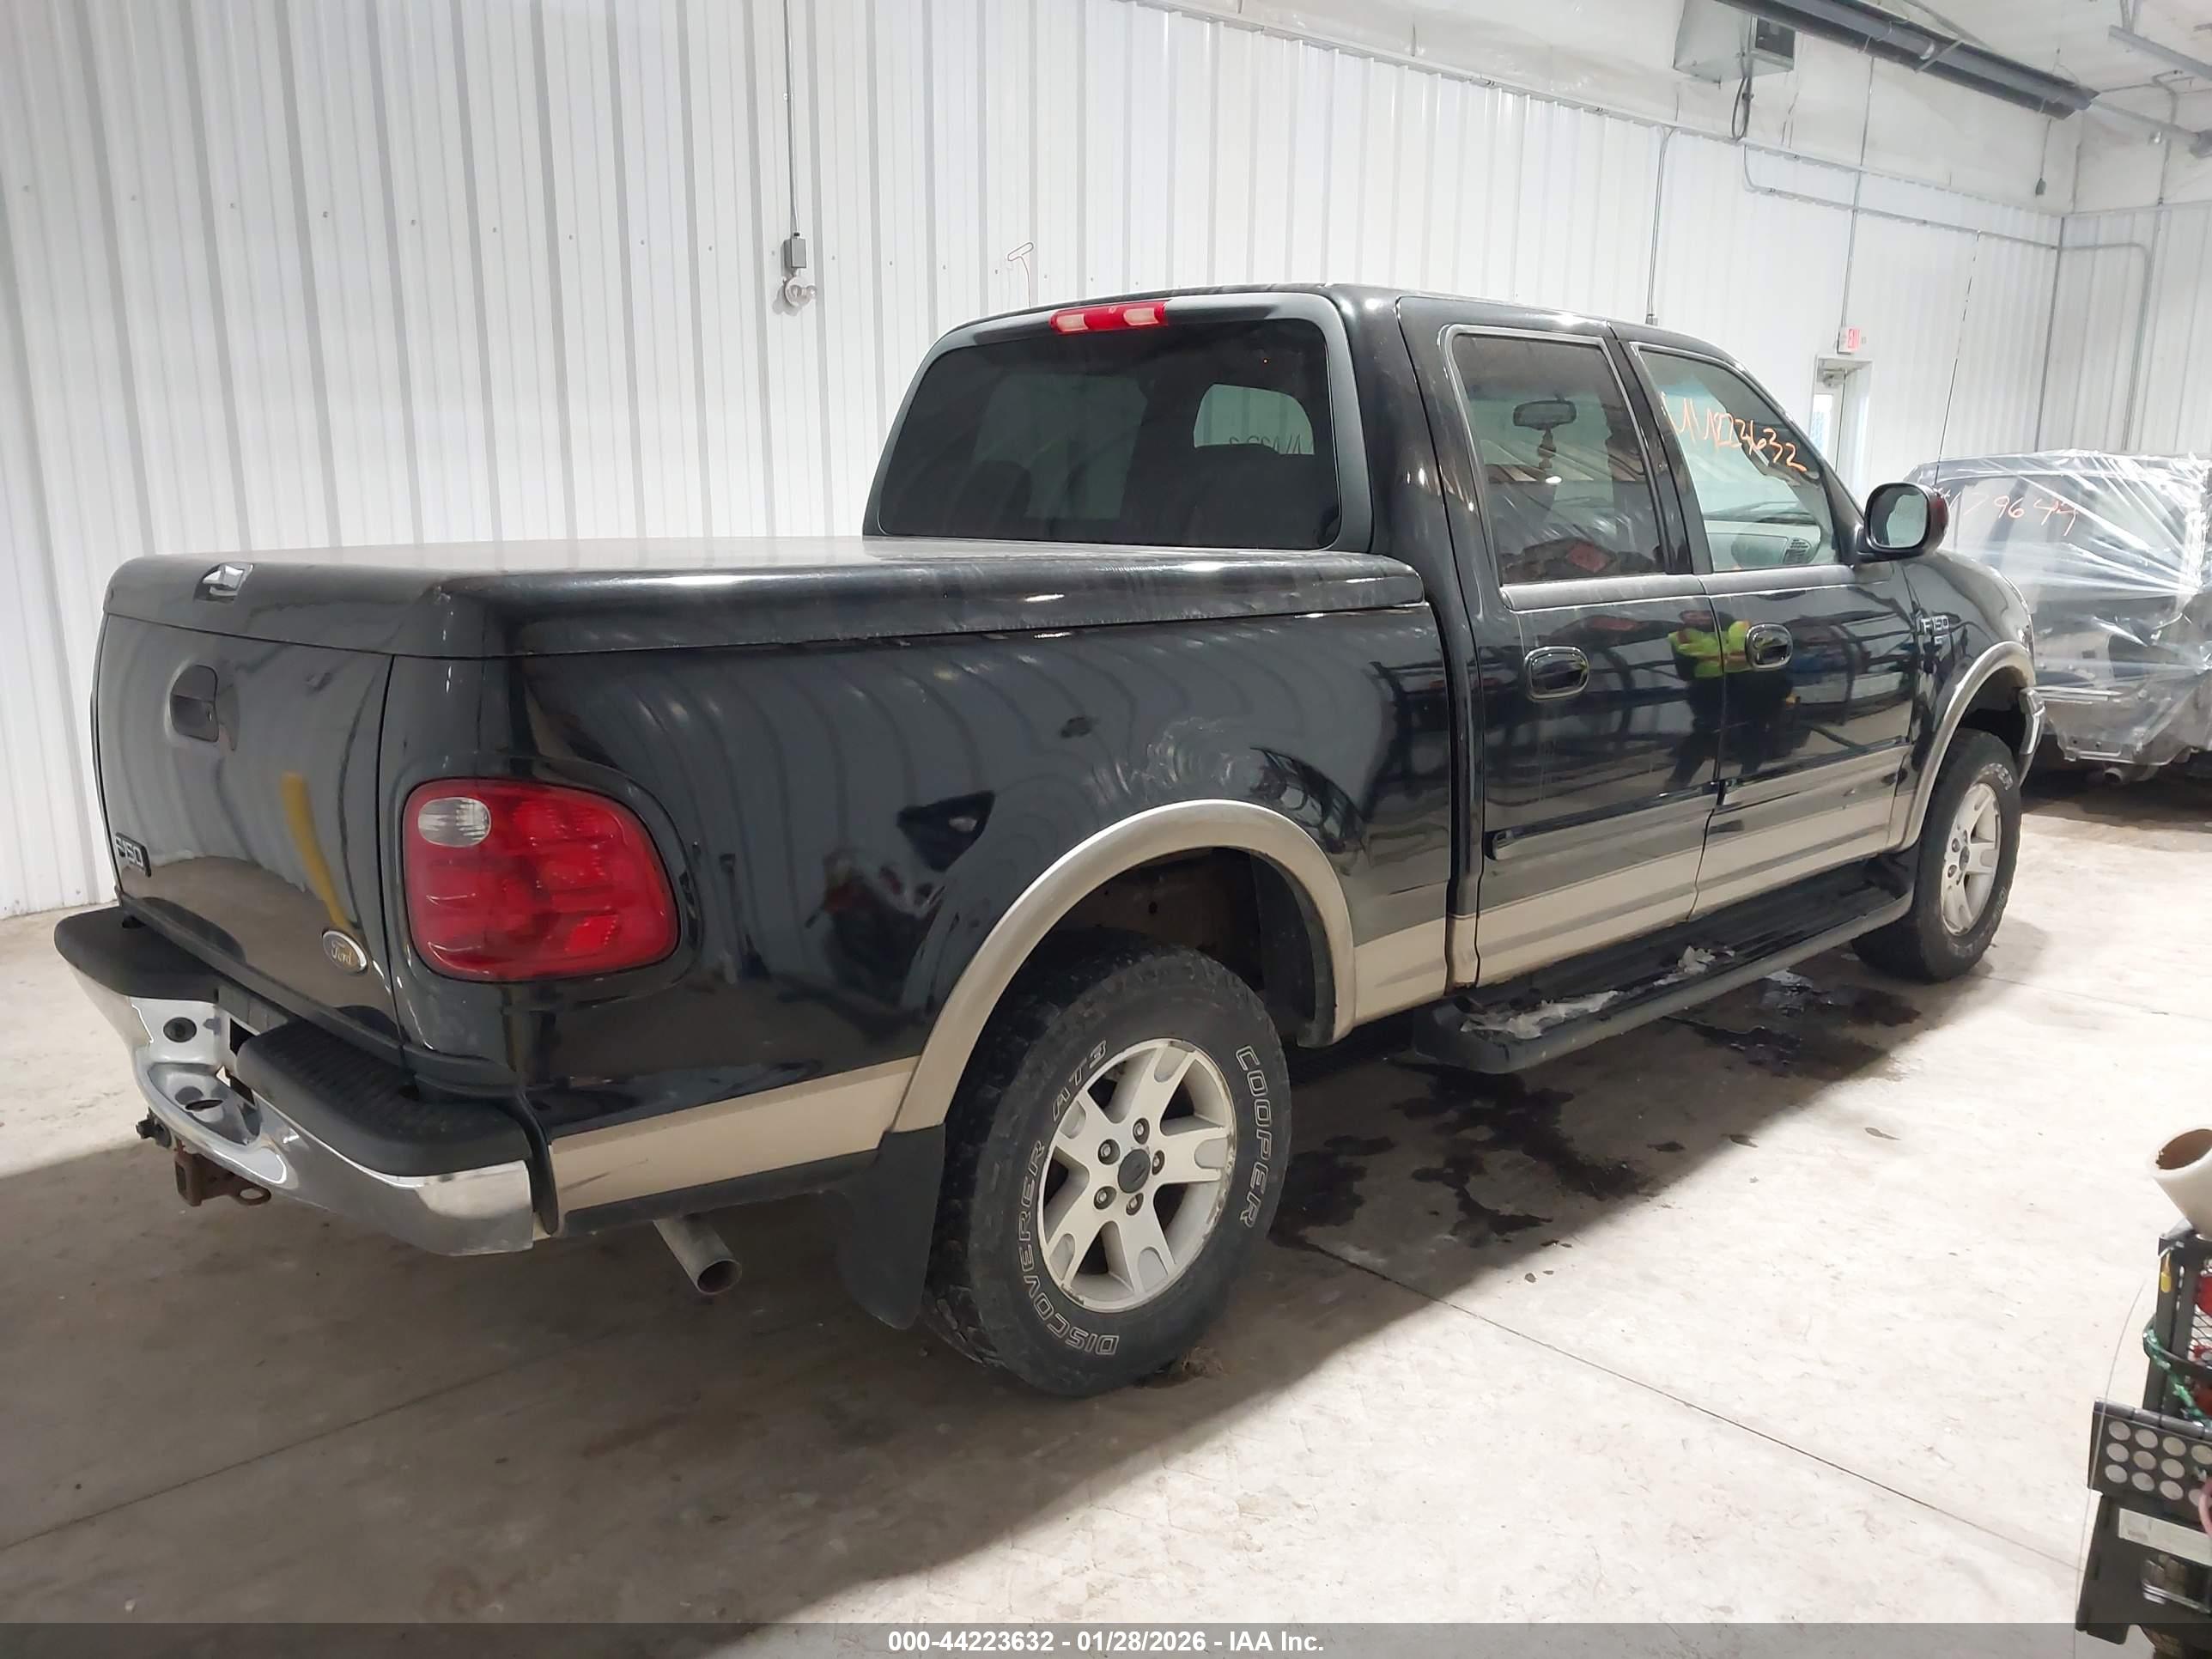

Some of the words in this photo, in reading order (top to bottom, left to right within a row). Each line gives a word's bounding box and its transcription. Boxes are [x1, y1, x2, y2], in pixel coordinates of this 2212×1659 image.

[1052, 1039, 1107, 1122] AT3
[1235, 1044, 1272, 1228] COOPER
[1018, 1139, 1120, 1356] DISCOVERER
